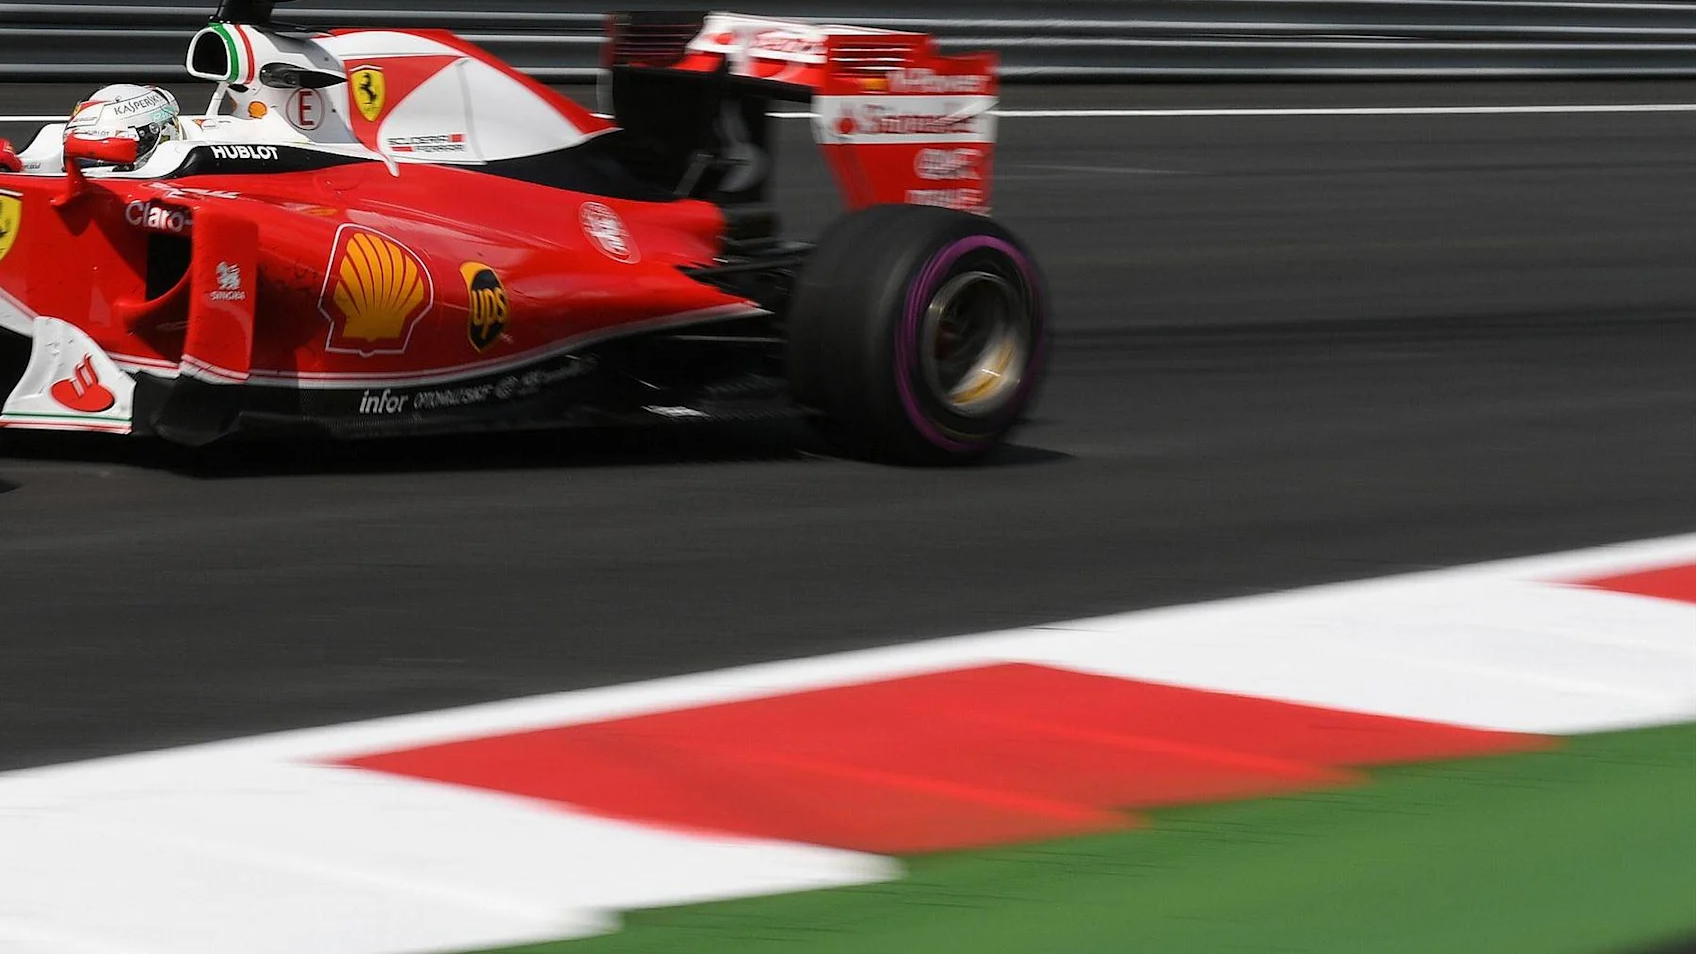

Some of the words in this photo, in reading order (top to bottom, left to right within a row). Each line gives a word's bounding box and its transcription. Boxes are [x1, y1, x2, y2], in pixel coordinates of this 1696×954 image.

[298, 91, 314, 126] E
[211, 145, 278, 160] HUBLOT
[471, 287, 508, 340] ups
[359, 389, 408, 414] infor
